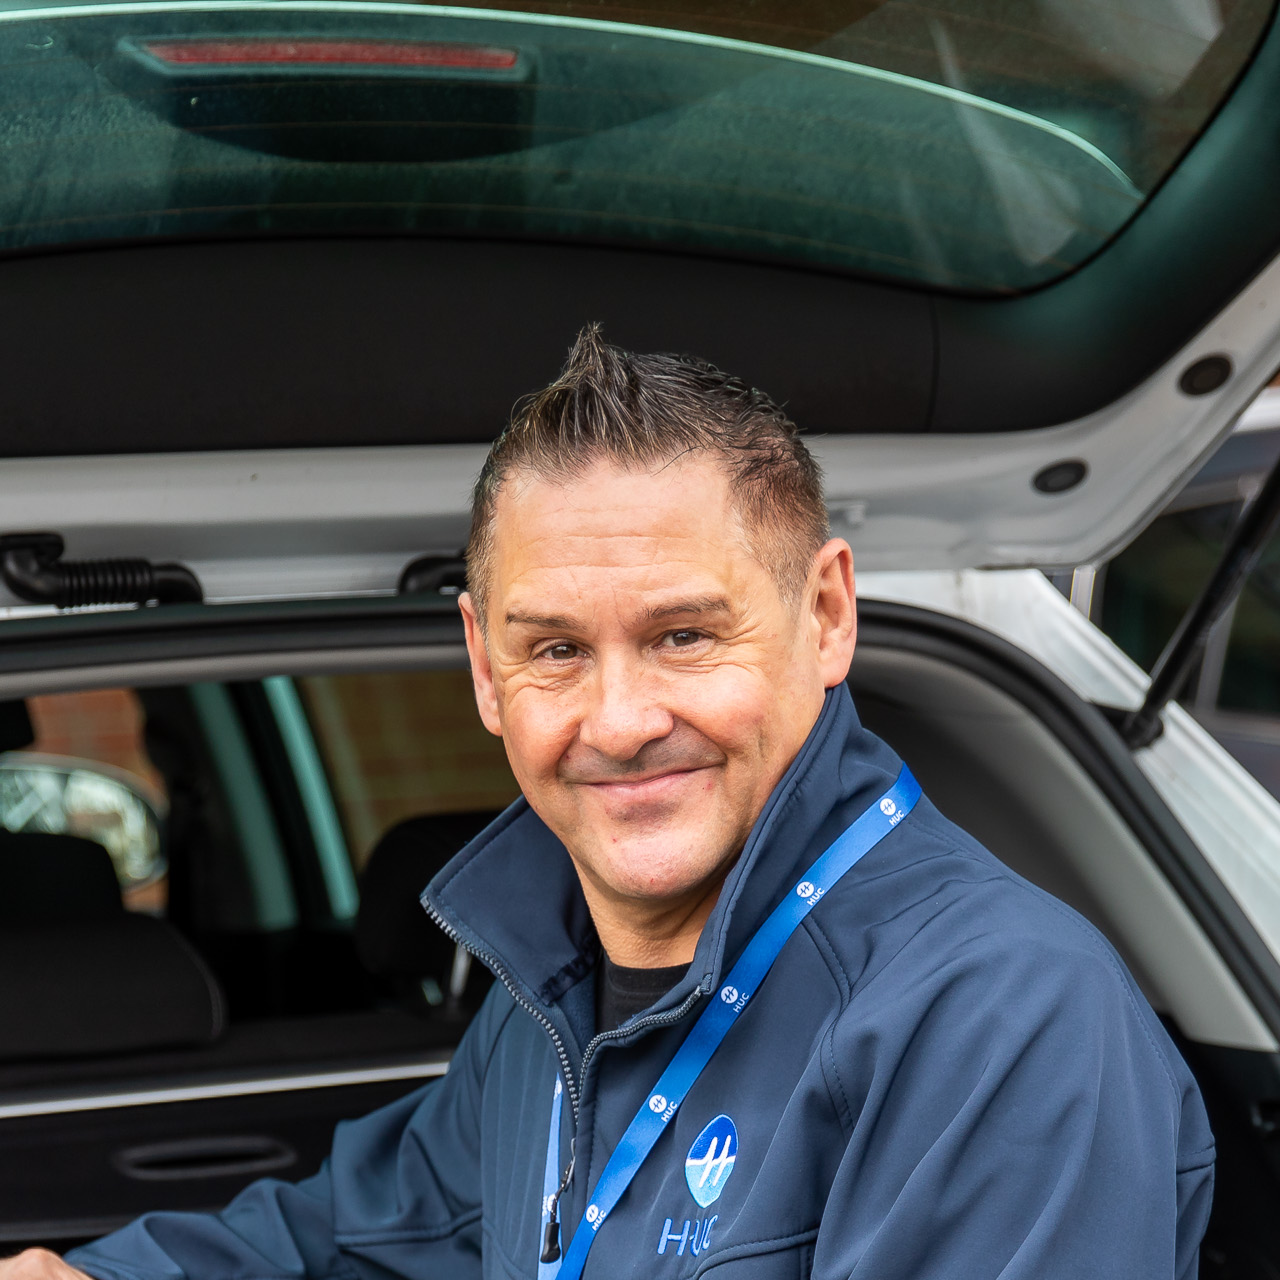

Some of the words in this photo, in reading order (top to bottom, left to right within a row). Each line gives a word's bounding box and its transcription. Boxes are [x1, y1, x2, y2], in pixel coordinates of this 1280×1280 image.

[889, 810, 904, 826] HUC
[807, 887, 825, 906] HUC
[733, 992, 750, 1013] HUC
[660, 1101, 678, 1122] HUC
[592, 1210, 606, 1231] HUC
[657, 1214, 719, 1257] HUC
